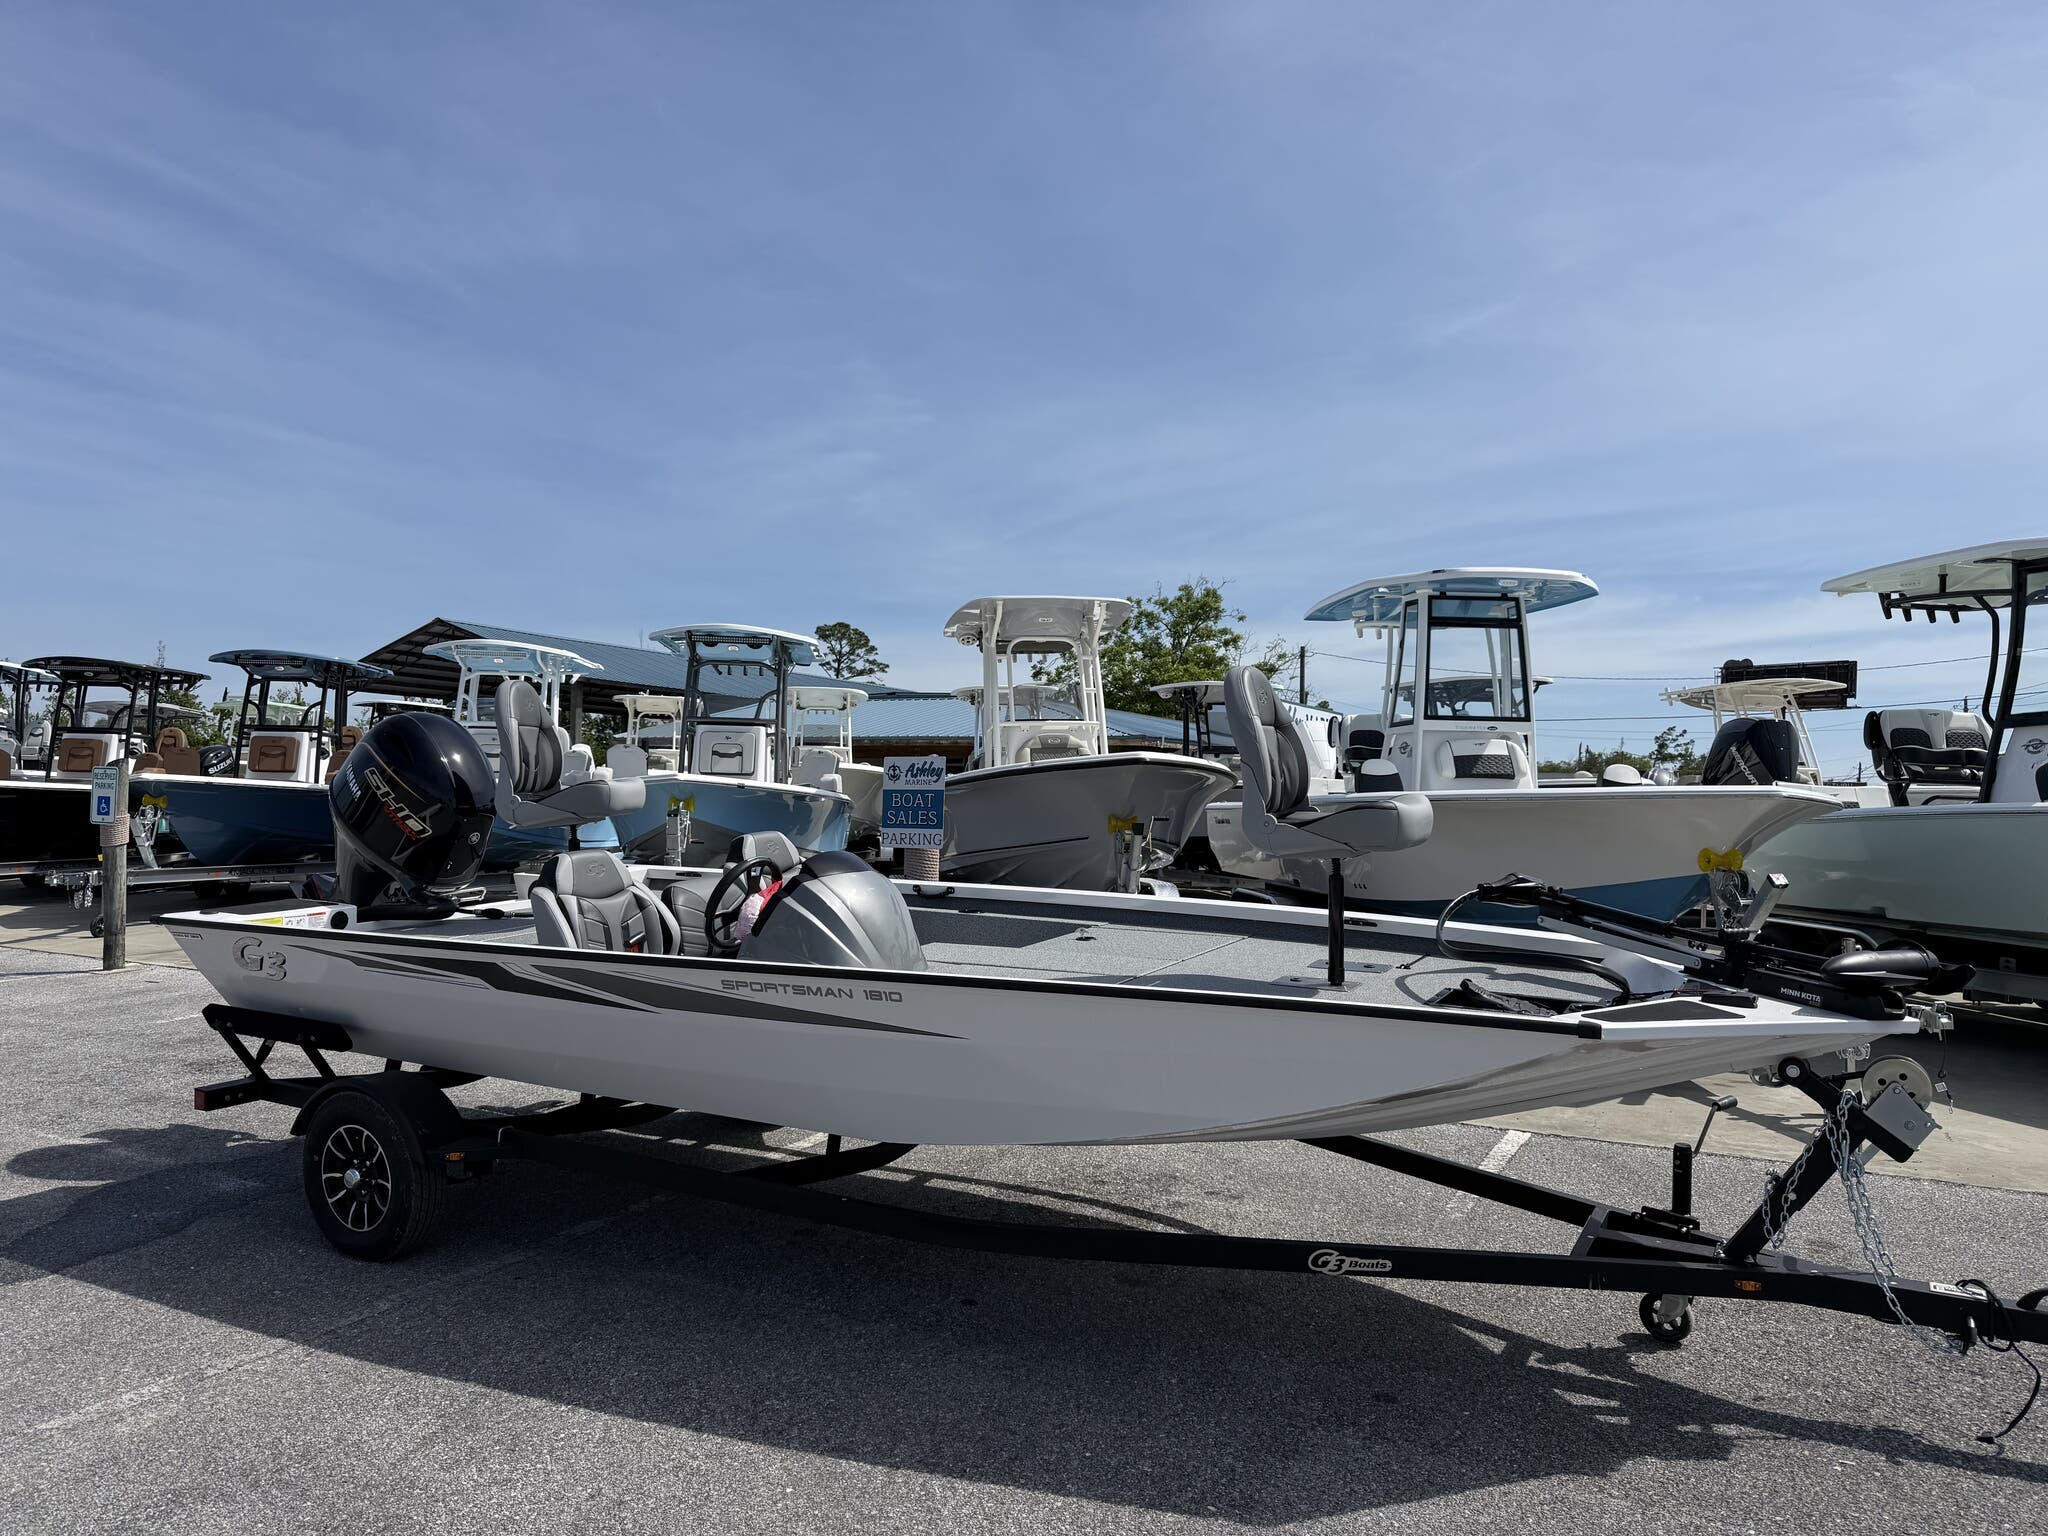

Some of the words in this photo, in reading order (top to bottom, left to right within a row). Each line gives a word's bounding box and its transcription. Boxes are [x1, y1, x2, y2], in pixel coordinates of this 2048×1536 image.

[207, 757, 234, 775] SUZUKI
[905, 761, 944, 783] Ashley
[94, 772, 116, 780] RESERVED
[345, 760, 361, 802] YAMAHA
[95, 781, 115, 789] PARKING
[892, 793, 935, 808] BOAT
[887, 810, 937, 825] SALES
[881, 832, 942, 846] PARKING
[232, 936, 287, 982] G3
[721, 979, 854, 999] SPORTSMAN
[863, 989, 903, 1003] 1810
[1780, 987, 1800, 998] MINN
[1801, 992, 1821, 1002] KOTA
[1308, 1249, 1346, 1275] G3
